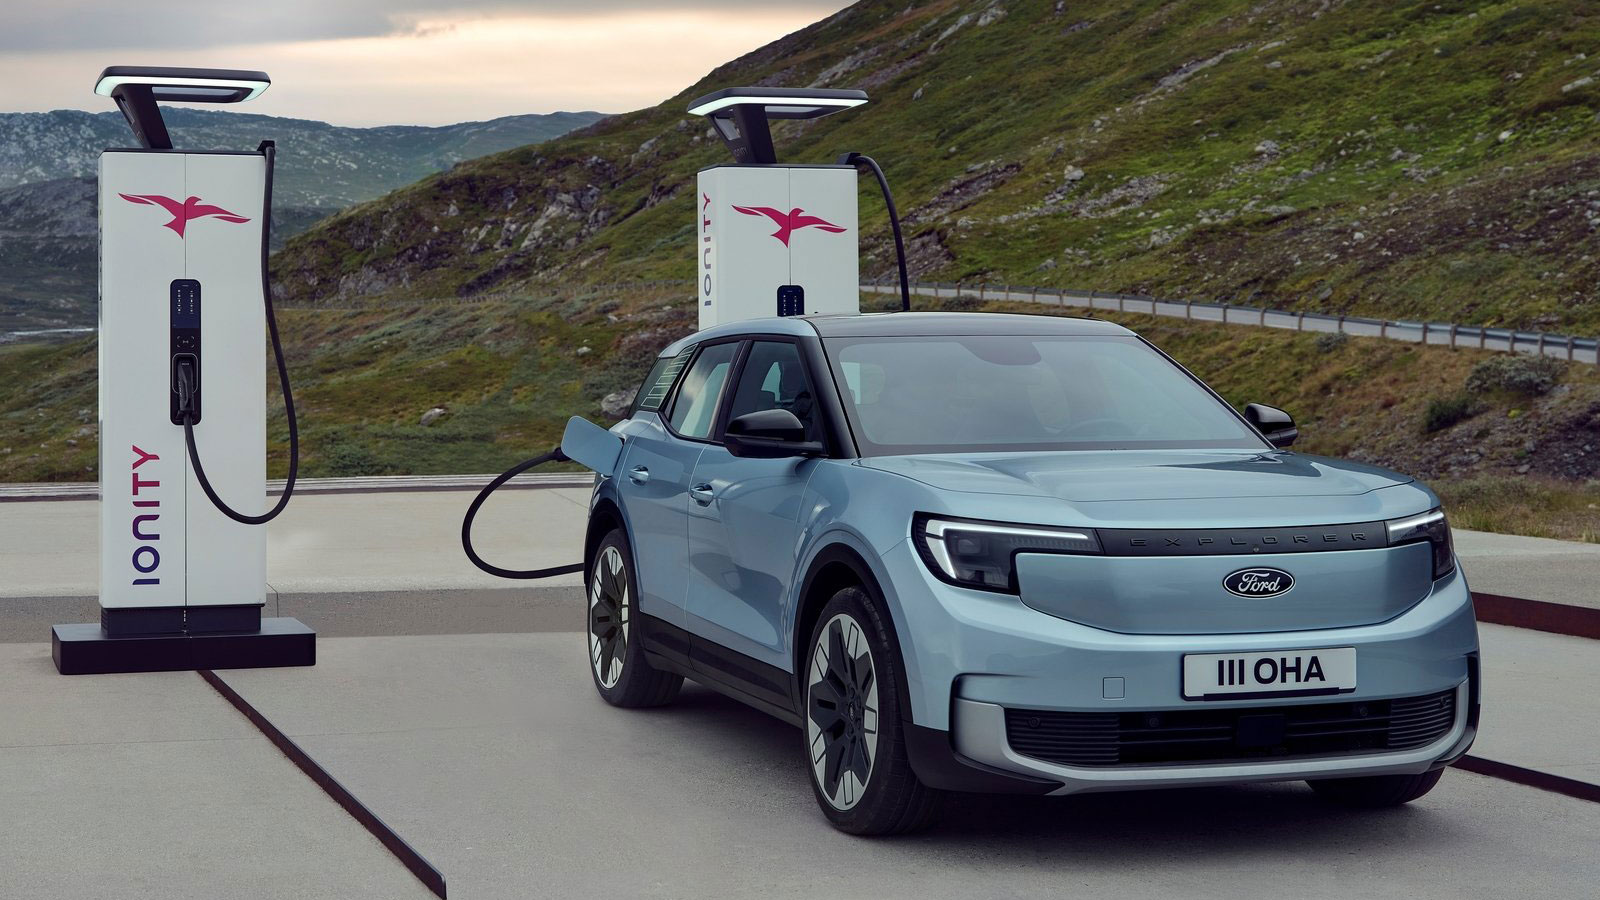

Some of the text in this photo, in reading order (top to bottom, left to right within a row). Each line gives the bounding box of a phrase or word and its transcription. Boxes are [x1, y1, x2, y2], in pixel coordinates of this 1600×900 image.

[703, 192, 711, 306] IONITY
[132, 445, 160, 585] IONITY
[1130, 532, 1368, 547] EXPLORER
[1238, 572, 1280, 592] Ford
[1253, 656, 1326, 684] OHA
